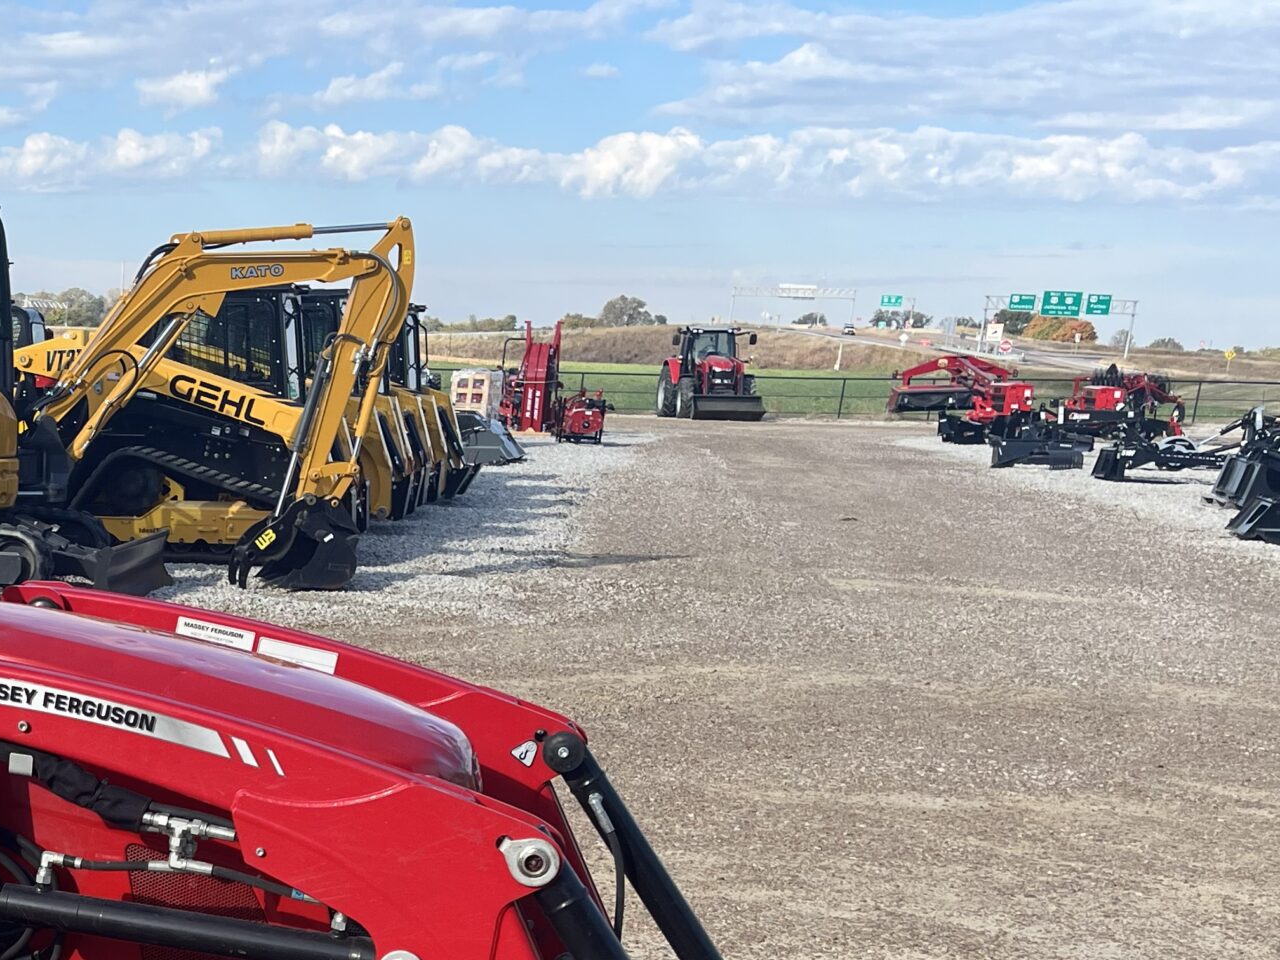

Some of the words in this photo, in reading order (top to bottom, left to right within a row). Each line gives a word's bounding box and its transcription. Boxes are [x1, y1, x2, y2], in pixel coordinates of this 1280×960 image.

[231, 264, 284, 279] KATO
[46, 349, 82, 372] VT2
[170, 375, 265, 426] GEHL
[183, 621, 210, 633] MASSEY
[210, 627, 245, 640] FERGUSON
[42, 691, 158, 733] FERGUSON
